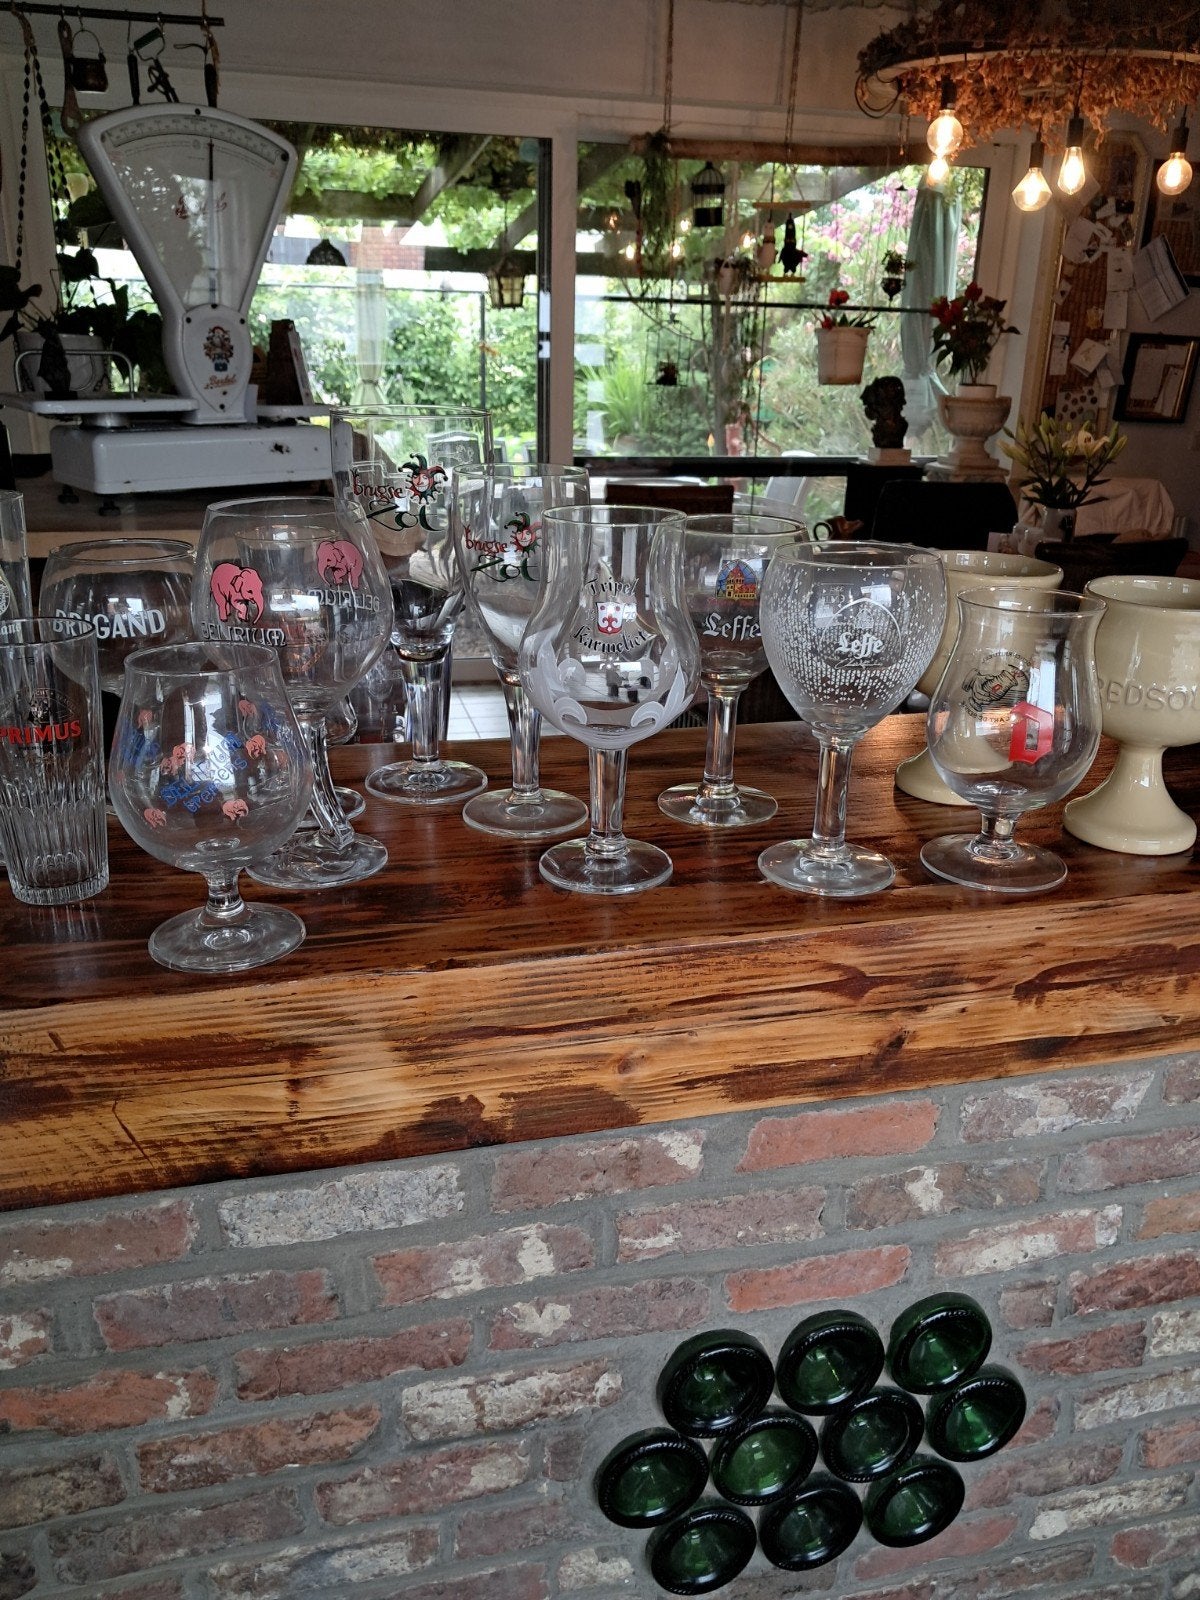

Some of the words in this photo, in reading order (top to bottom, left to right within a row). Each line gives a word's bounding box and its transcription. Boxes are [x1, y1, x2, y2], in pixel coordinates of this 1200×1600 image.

[585, 577, 640, 597] Tripel
[53, 609, 165, 640] BRIGAND
[702, 612, 762, 641] Leffe
[835, 631, 884, 659] Leffe
[1098, 679, 1200, 711] EDSO
[0, 720, 81, 746] PRIMUS
